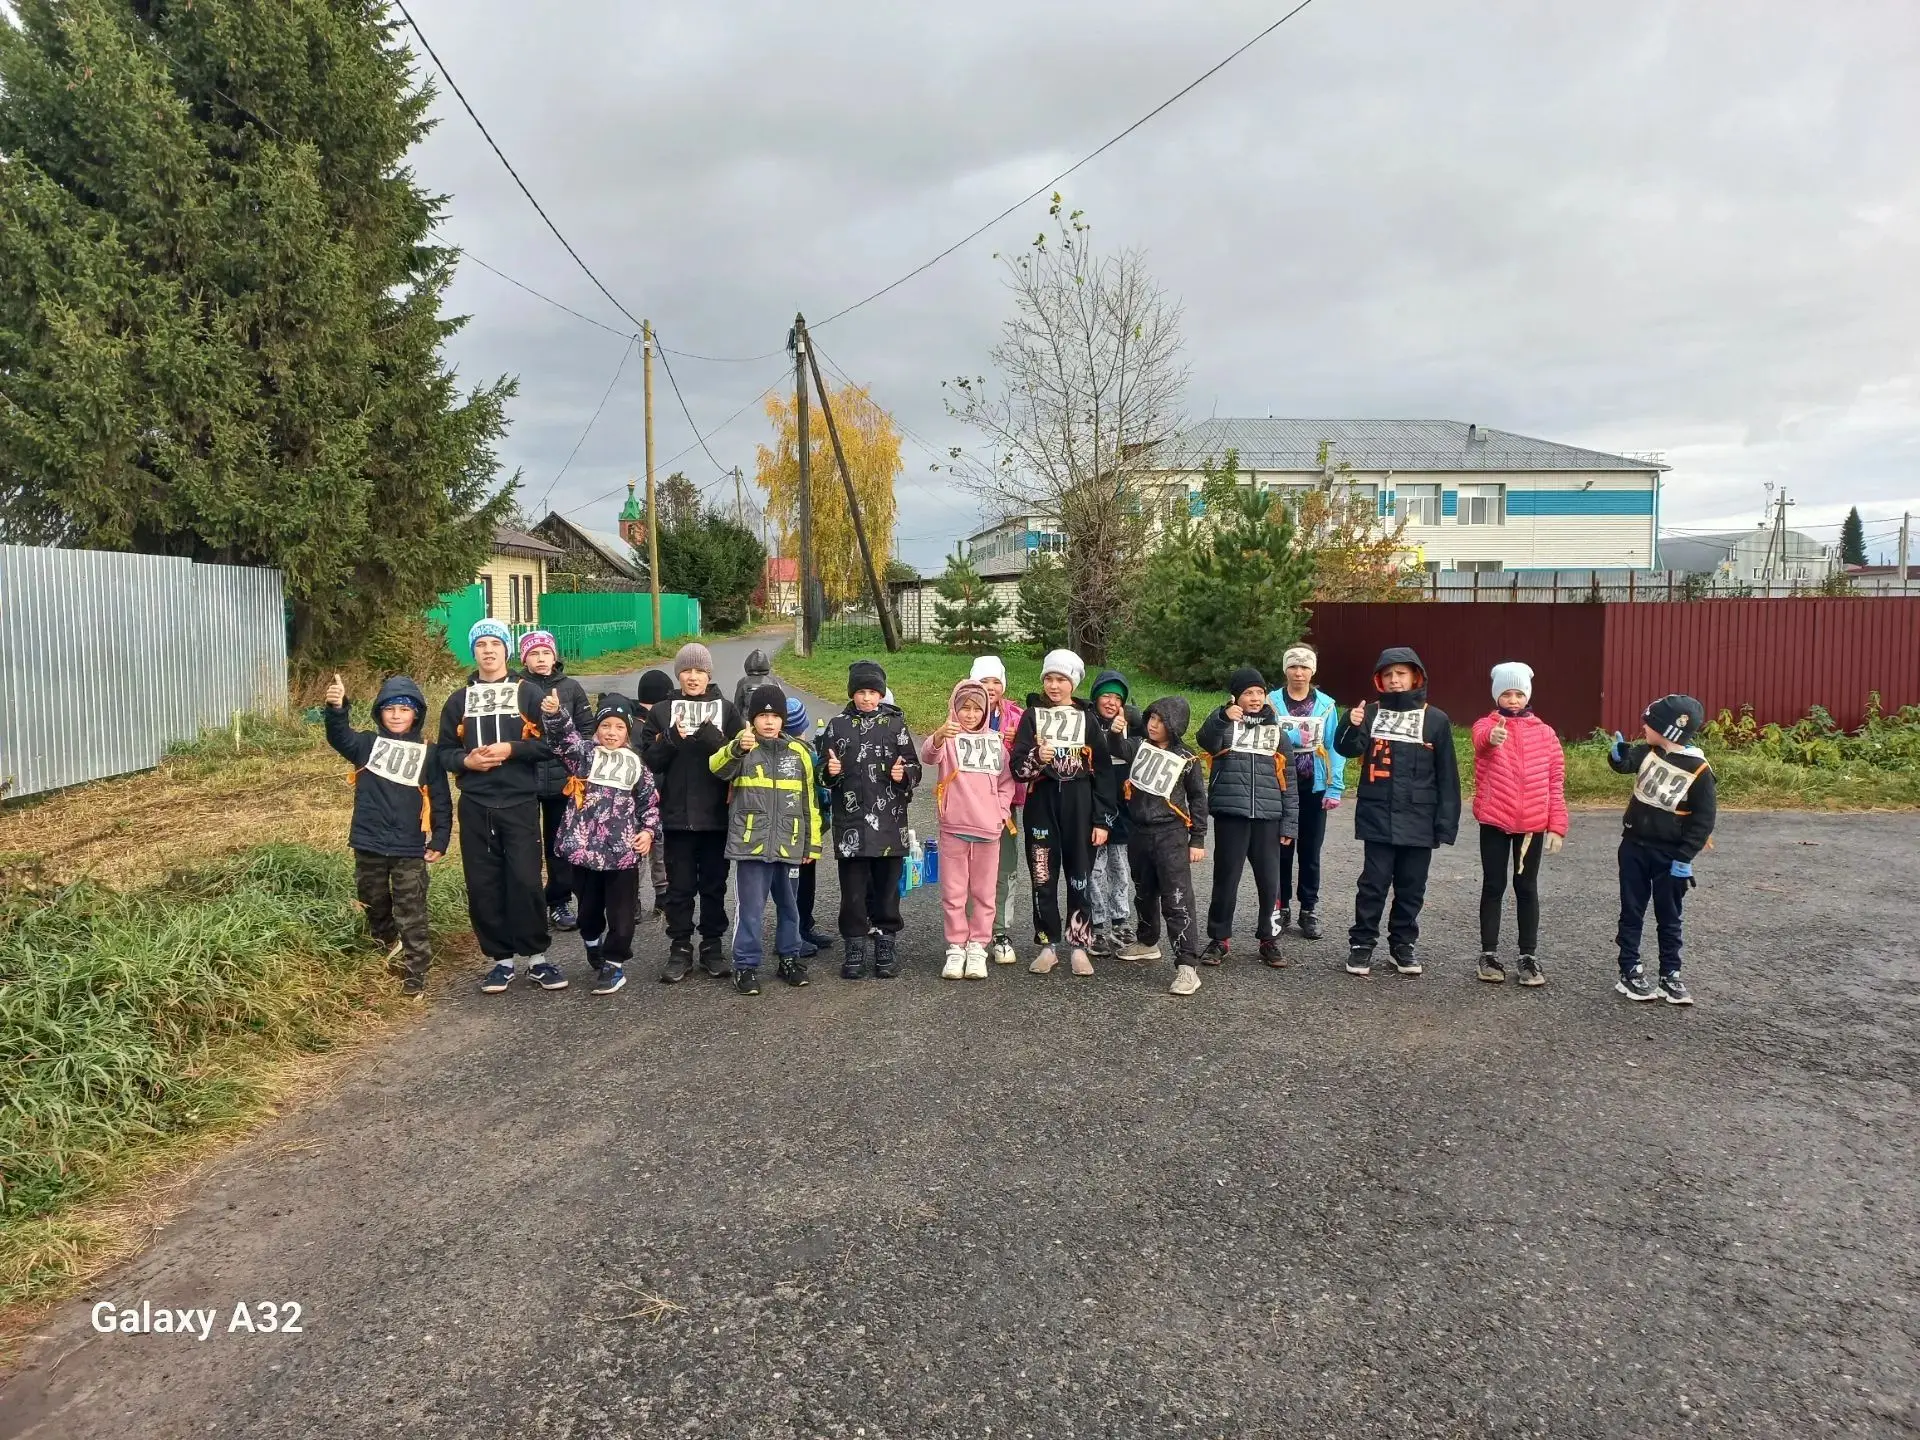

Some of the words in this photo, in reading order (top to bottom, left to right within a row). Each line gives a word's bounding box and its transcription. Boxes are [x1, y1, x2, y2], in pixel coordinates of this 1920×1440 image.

[468, 687, 515, 713] 232
[1039, 710, 1082, 742] 227
[371, 740, 421, 780] 208
[593, 751, 637, 785] 228
[959, 737, 1001, 770] 225
[1131, 749, 1179, 794] 205
[1637, 760, 1688, 807] 183
